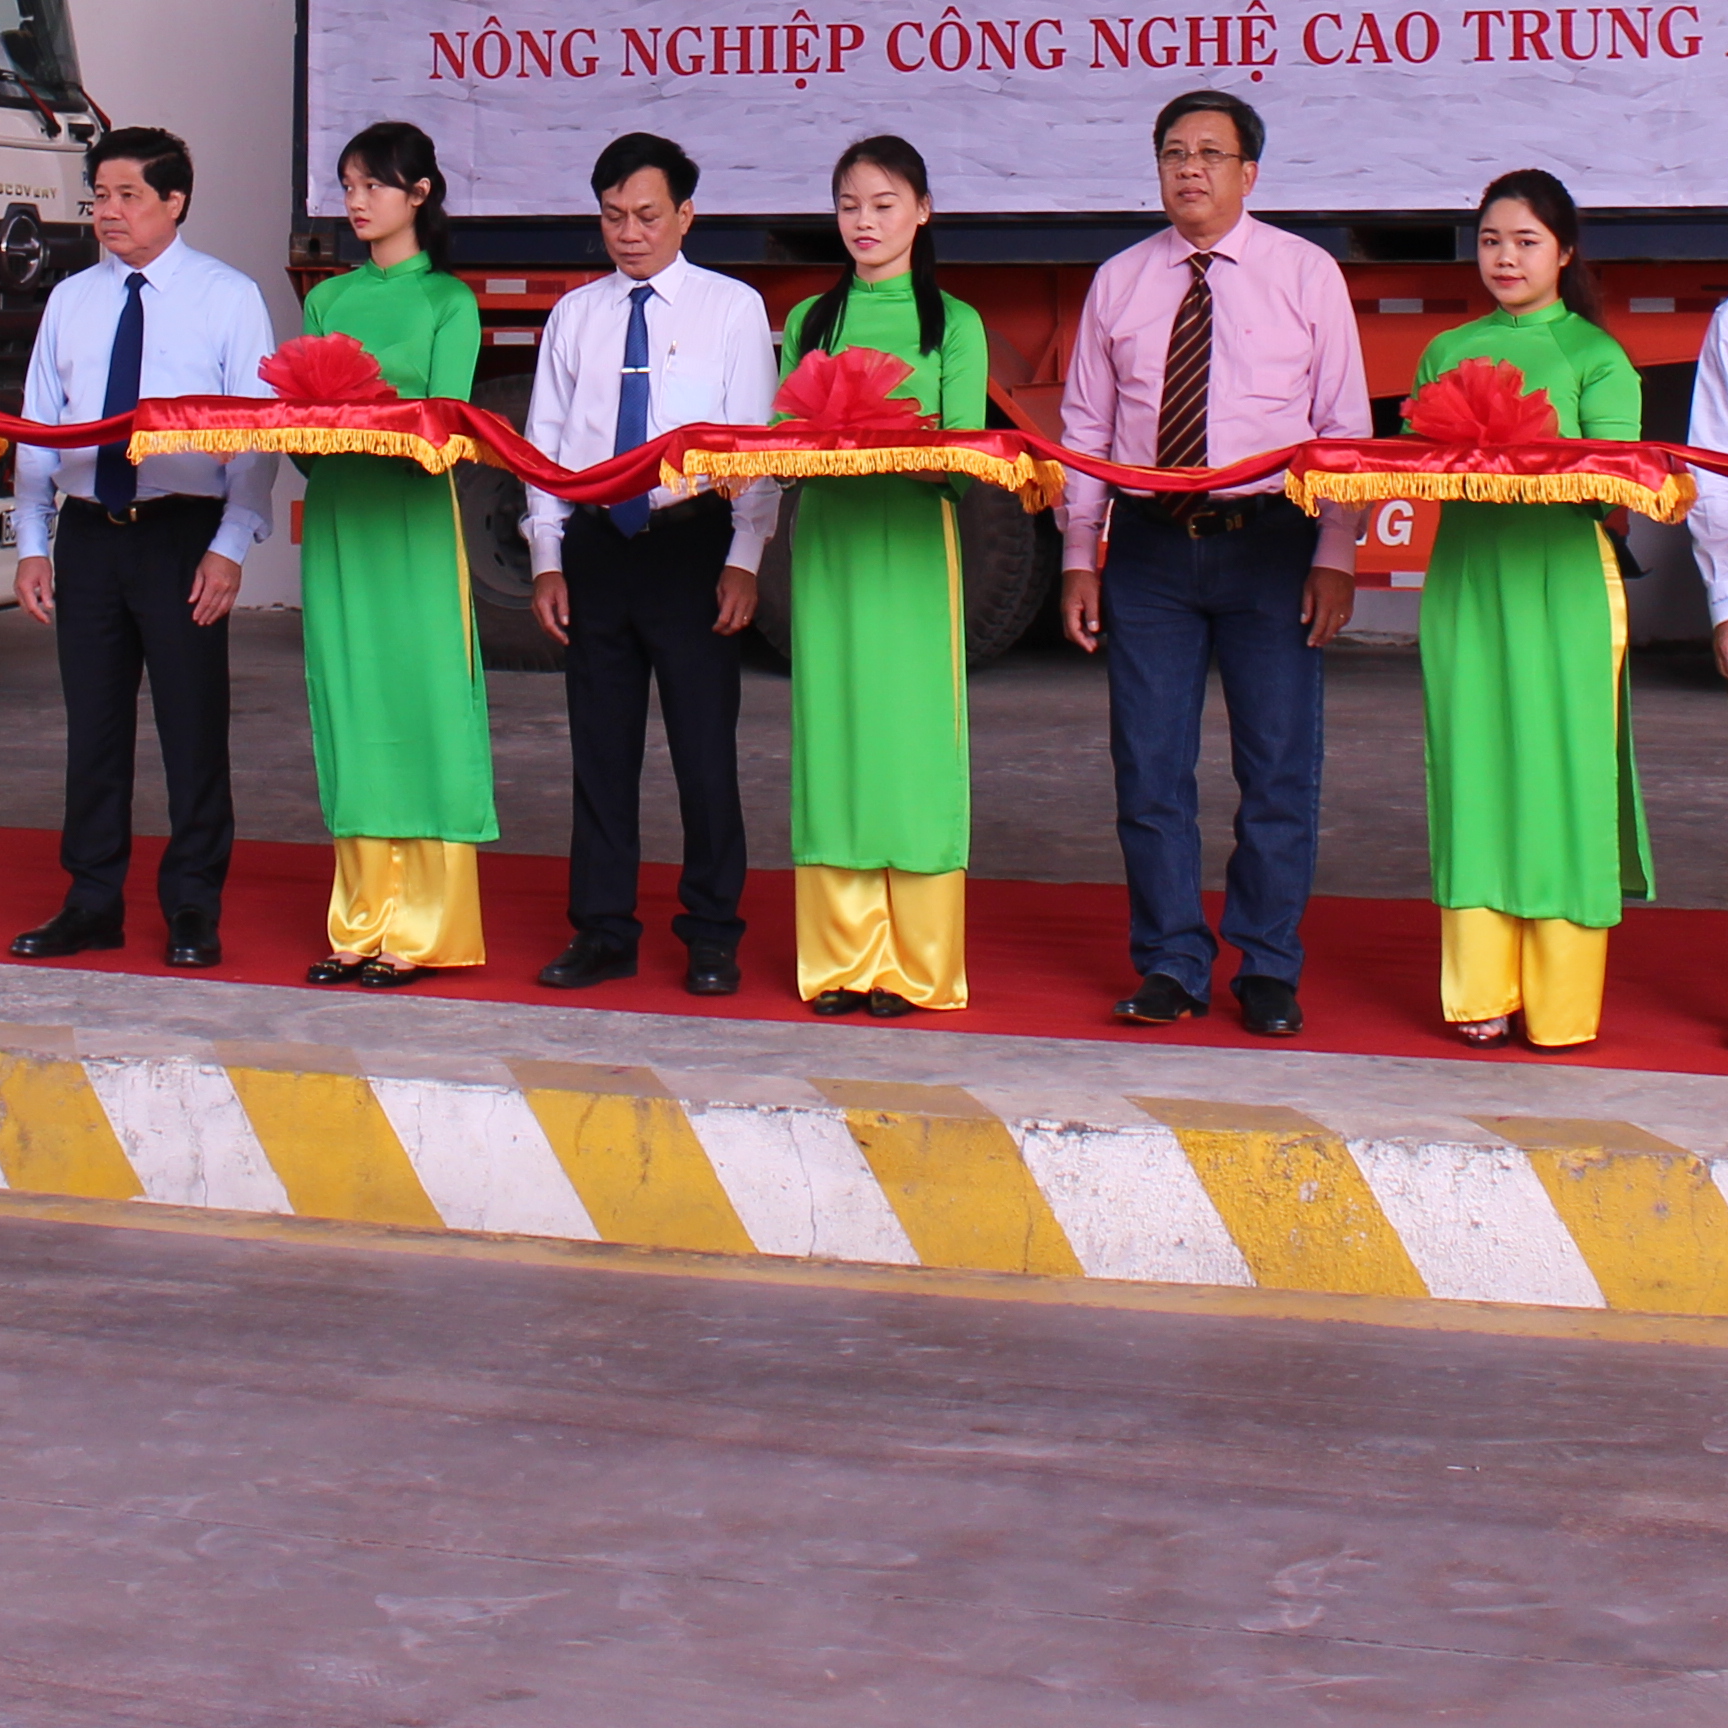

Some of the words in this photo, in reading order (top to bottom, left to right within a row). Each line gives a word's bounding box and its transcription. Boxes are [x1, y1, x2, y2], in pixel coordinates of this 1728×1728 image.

[429, 17, 600, 80] NÔNG
[621, 10, 866, 93] NGHIỆP
[886, 5, 1066, 73] CÔNG
[1089, 0, 1278, 84] NGHỆ
[1302, 11, 1440, 66] CAO
[1462, 5, 1703, 62] TRUNG
